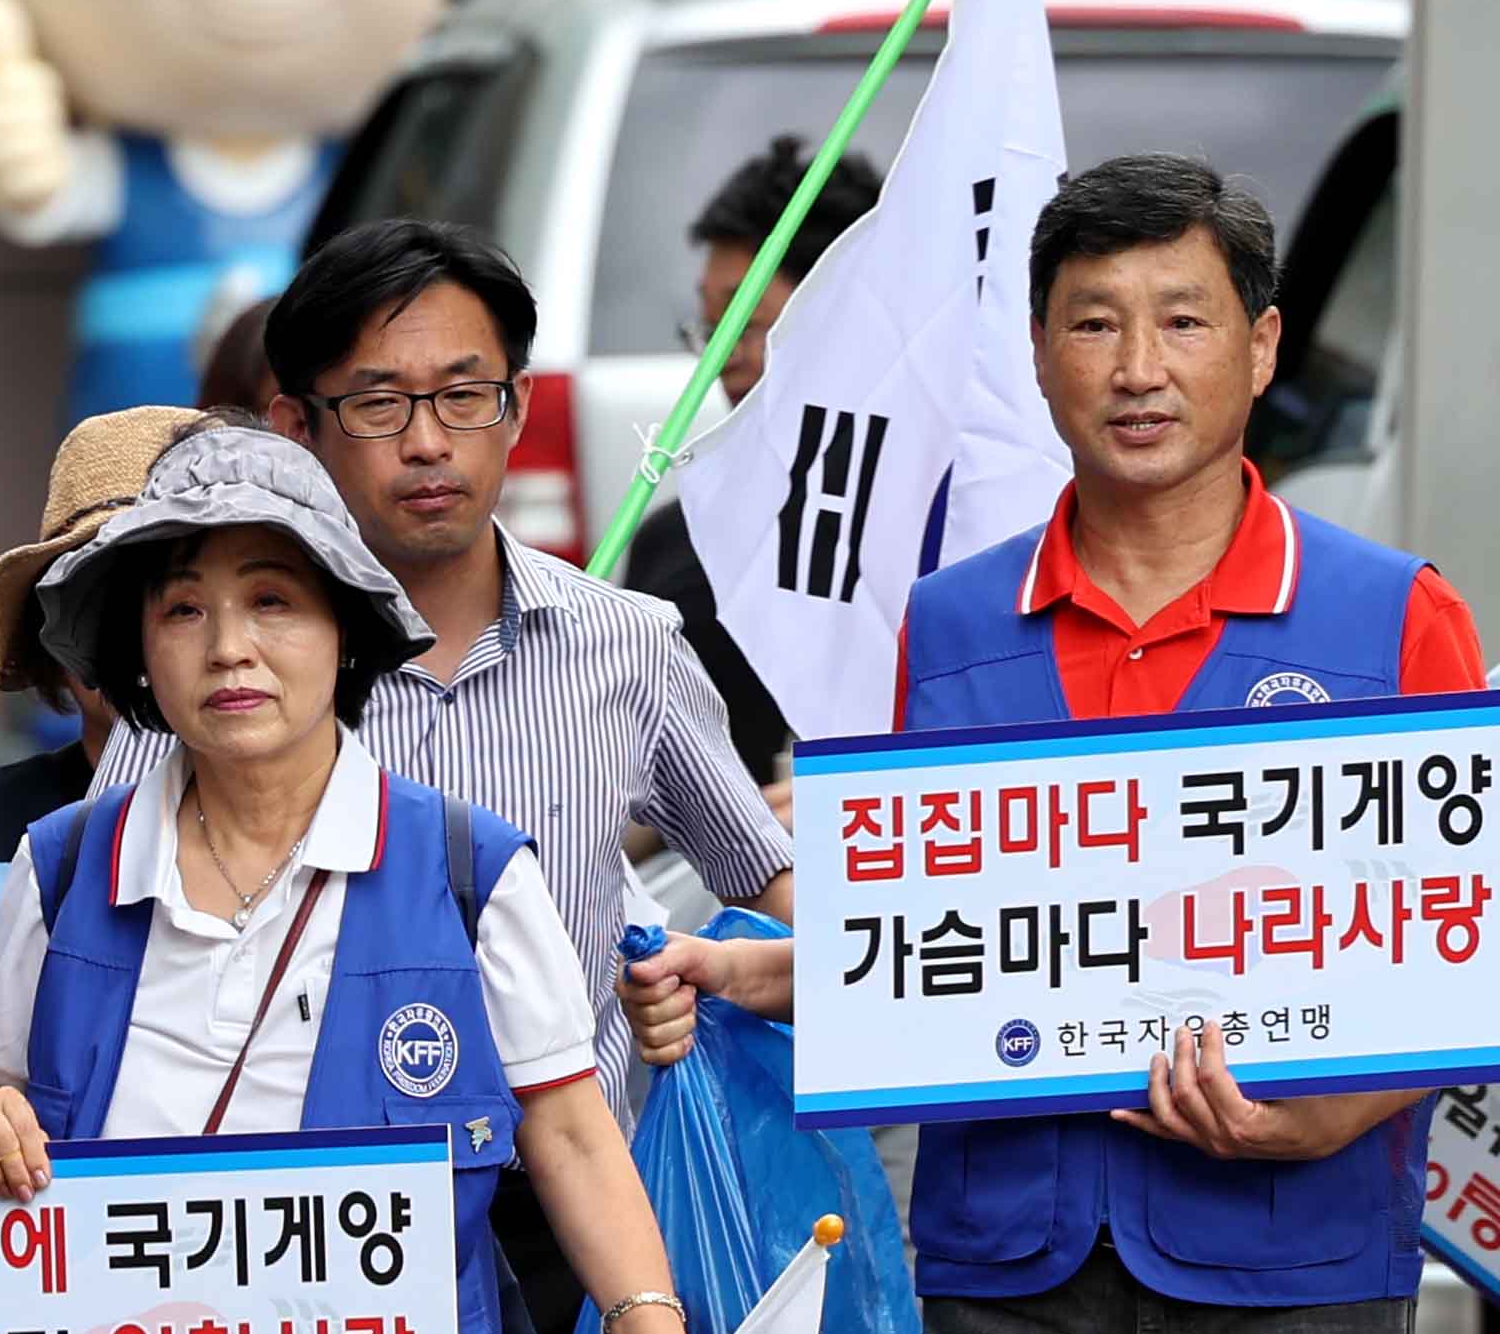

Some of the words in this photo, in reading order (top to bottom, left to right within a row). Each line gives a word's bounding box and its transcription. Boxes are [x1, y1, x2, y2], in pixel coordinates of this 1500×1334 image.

[842, 778, 1148, 883] 집집마다
[1180, 754, 1493, 856] 국기게양
[843, 898, 1149, 999] 가슴마다
[1184, 874, 1492, 975] 나라사랑
[396, 1039, 443, 1066] KFF
[1003, 1036, 1033, 1052] KFF
[105, 1190, 412, 1289] 국기게양
